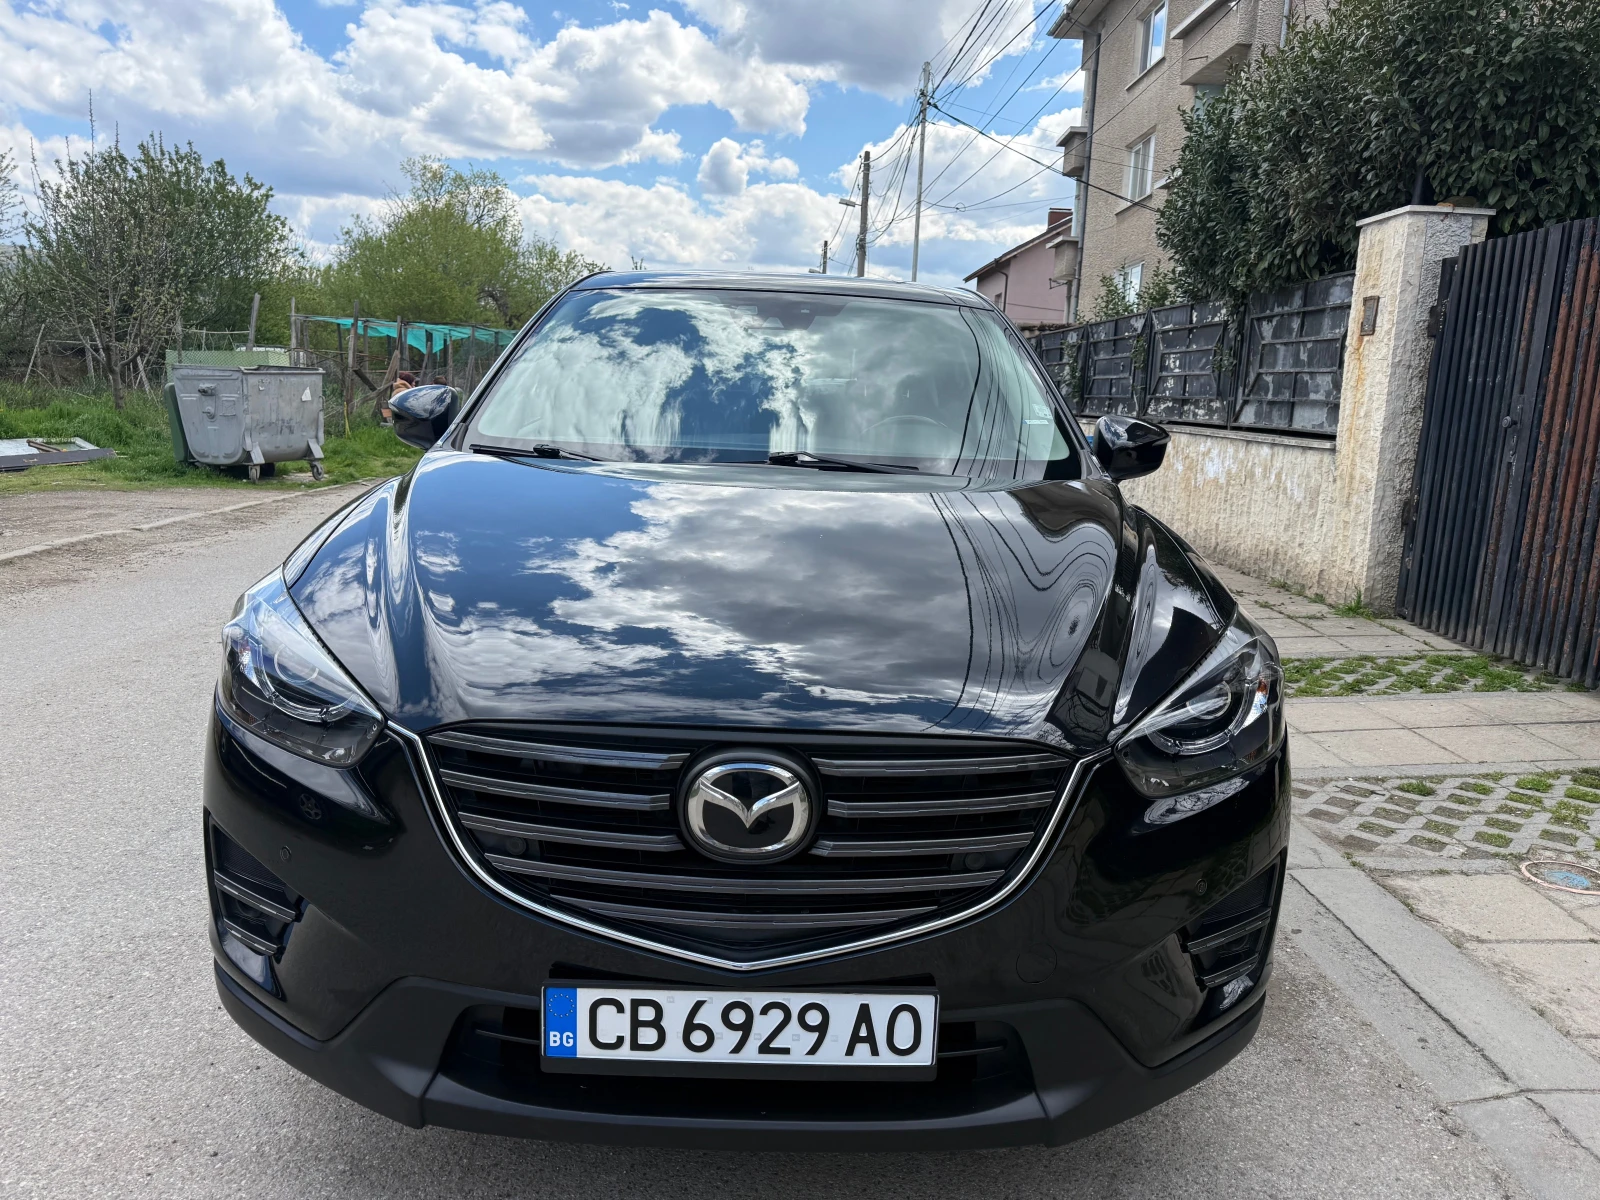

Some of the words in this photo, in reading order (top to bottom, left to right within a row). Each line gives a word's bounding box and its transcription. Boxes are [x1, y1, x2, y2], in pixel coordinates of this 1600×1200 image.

[549, 1031, 575, 1047] BG
[588, 997, 667, 1052] CB
[682, 999, 830, 1056] 6929
[844, 1003, 922, 1057] AO
